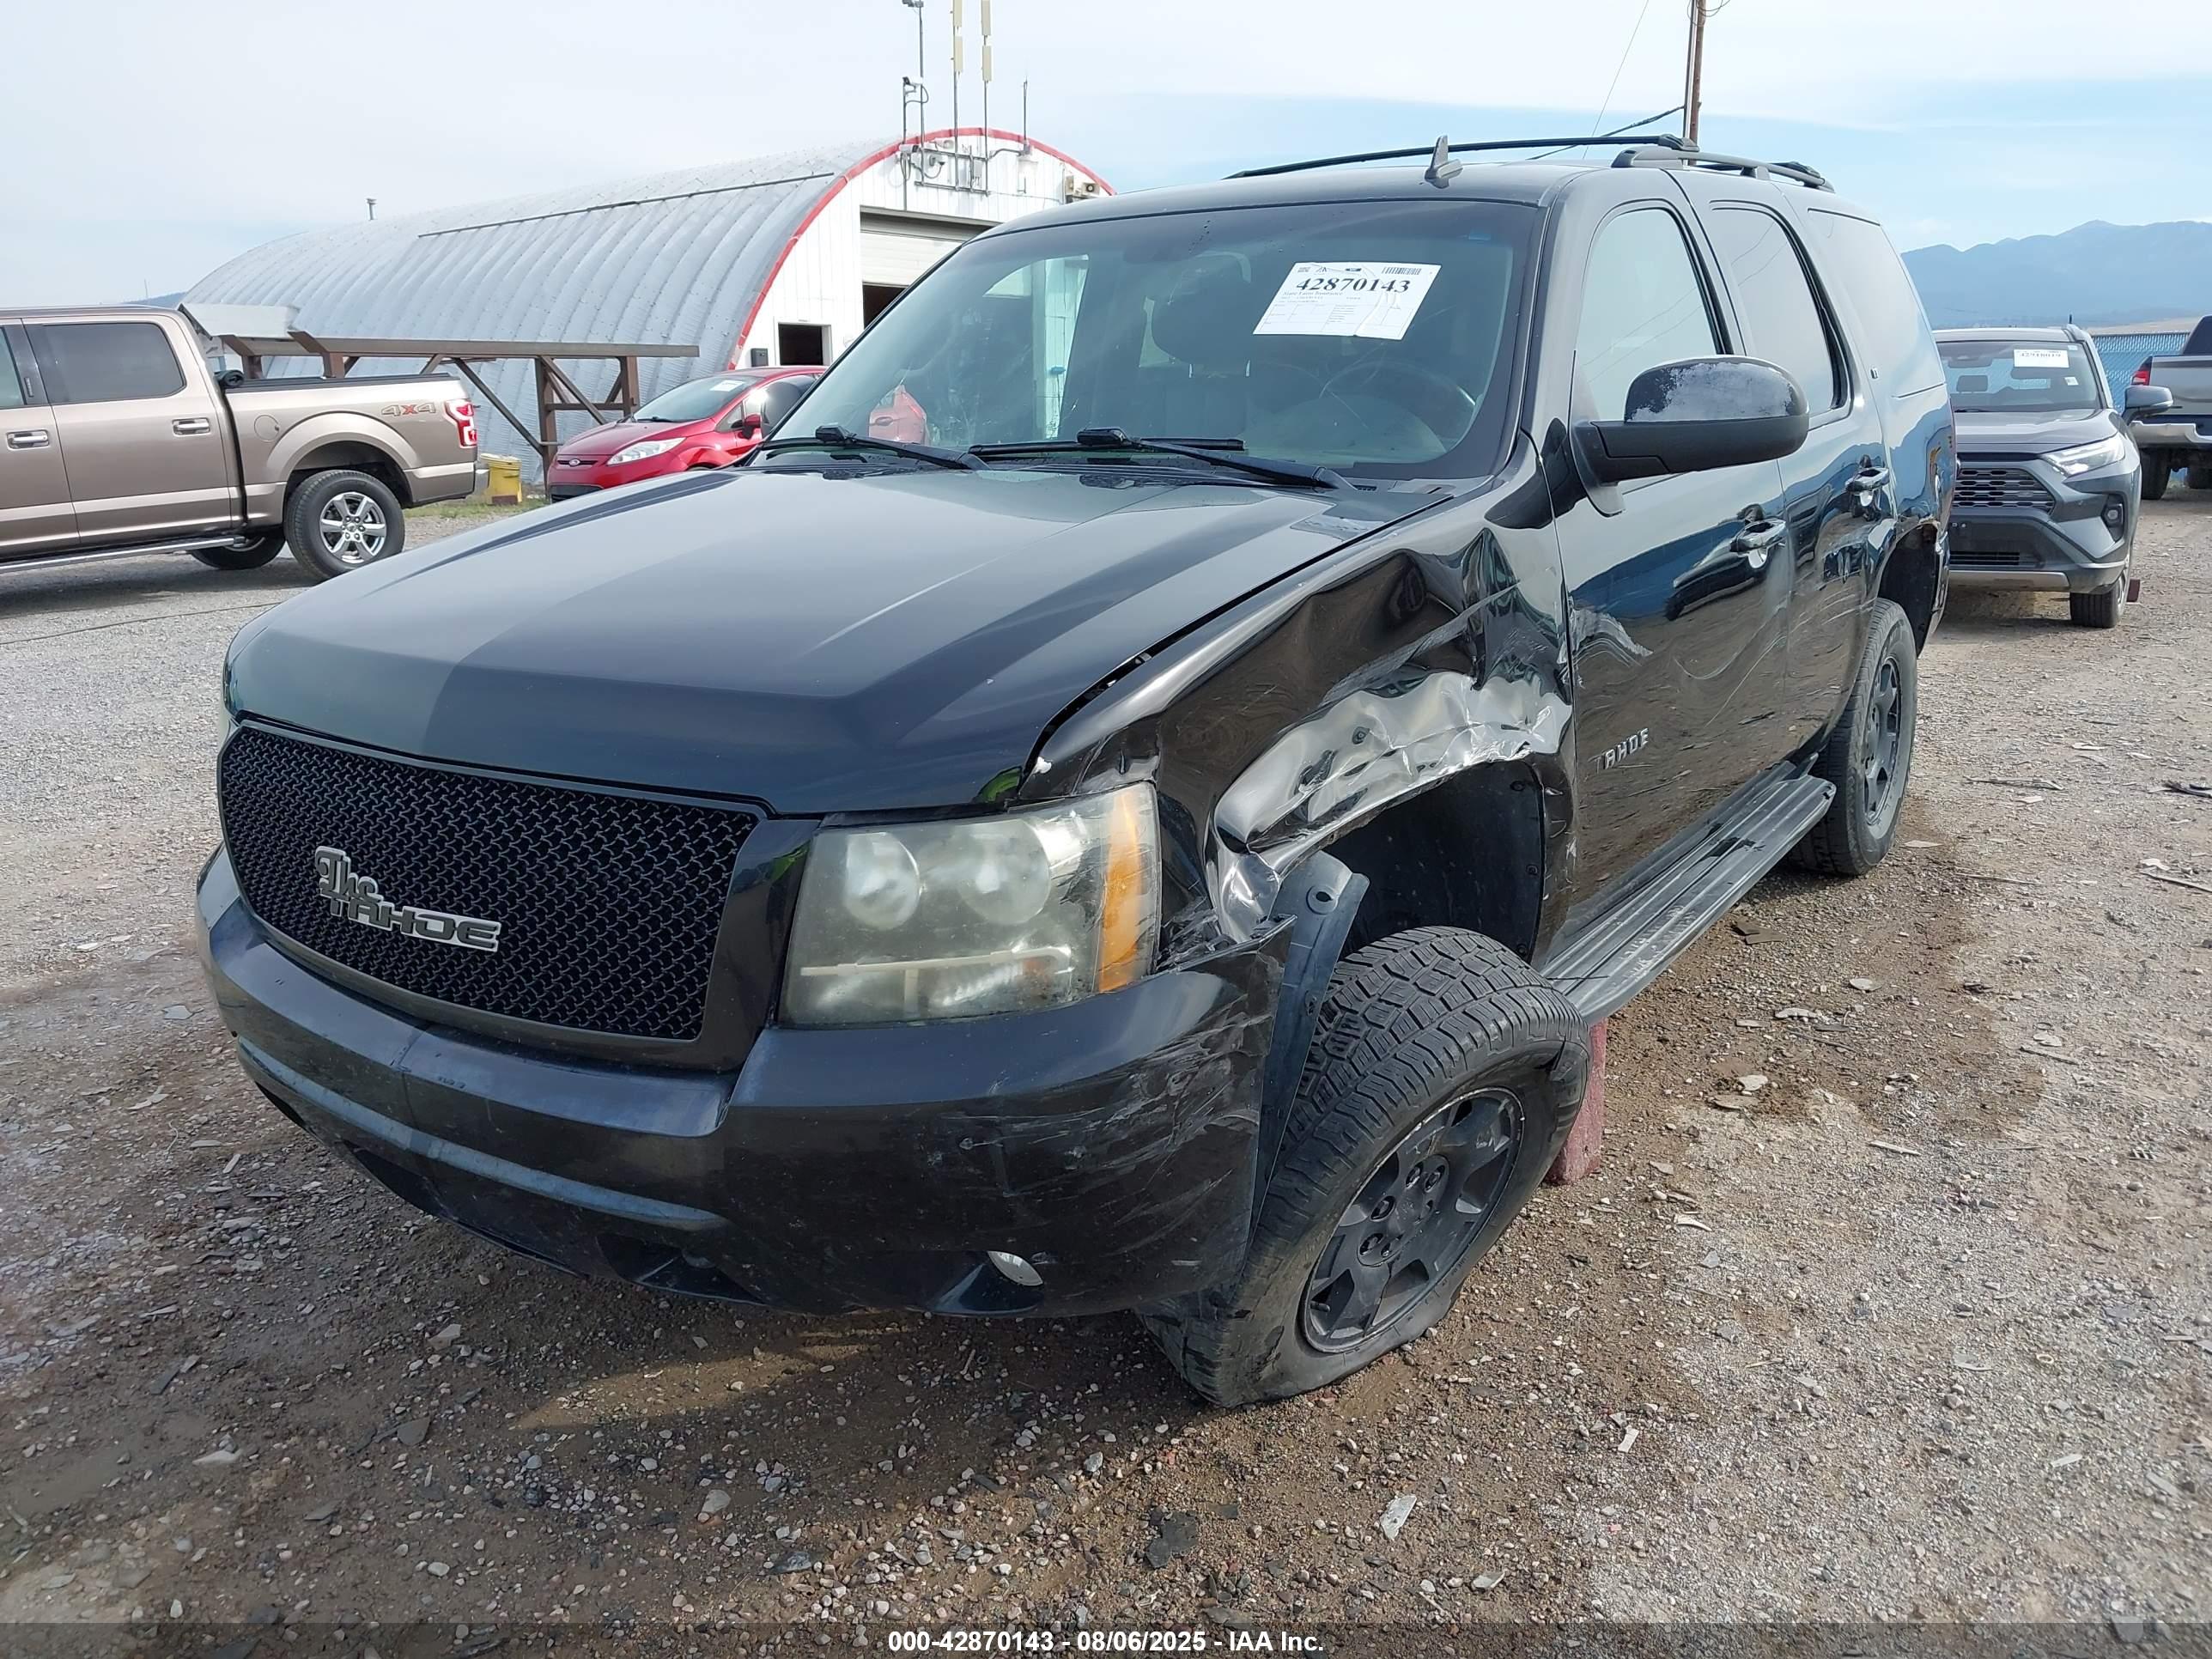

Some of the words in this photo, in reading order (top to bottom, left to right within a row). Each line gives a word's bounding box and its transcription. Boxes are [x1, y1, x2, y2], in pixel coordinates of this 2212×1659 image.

[1296, 277, 1411, 293] 42870143
[1587, 727, 1649, 773] TAHOE
[329, 894, 501, 952] TAHOE
